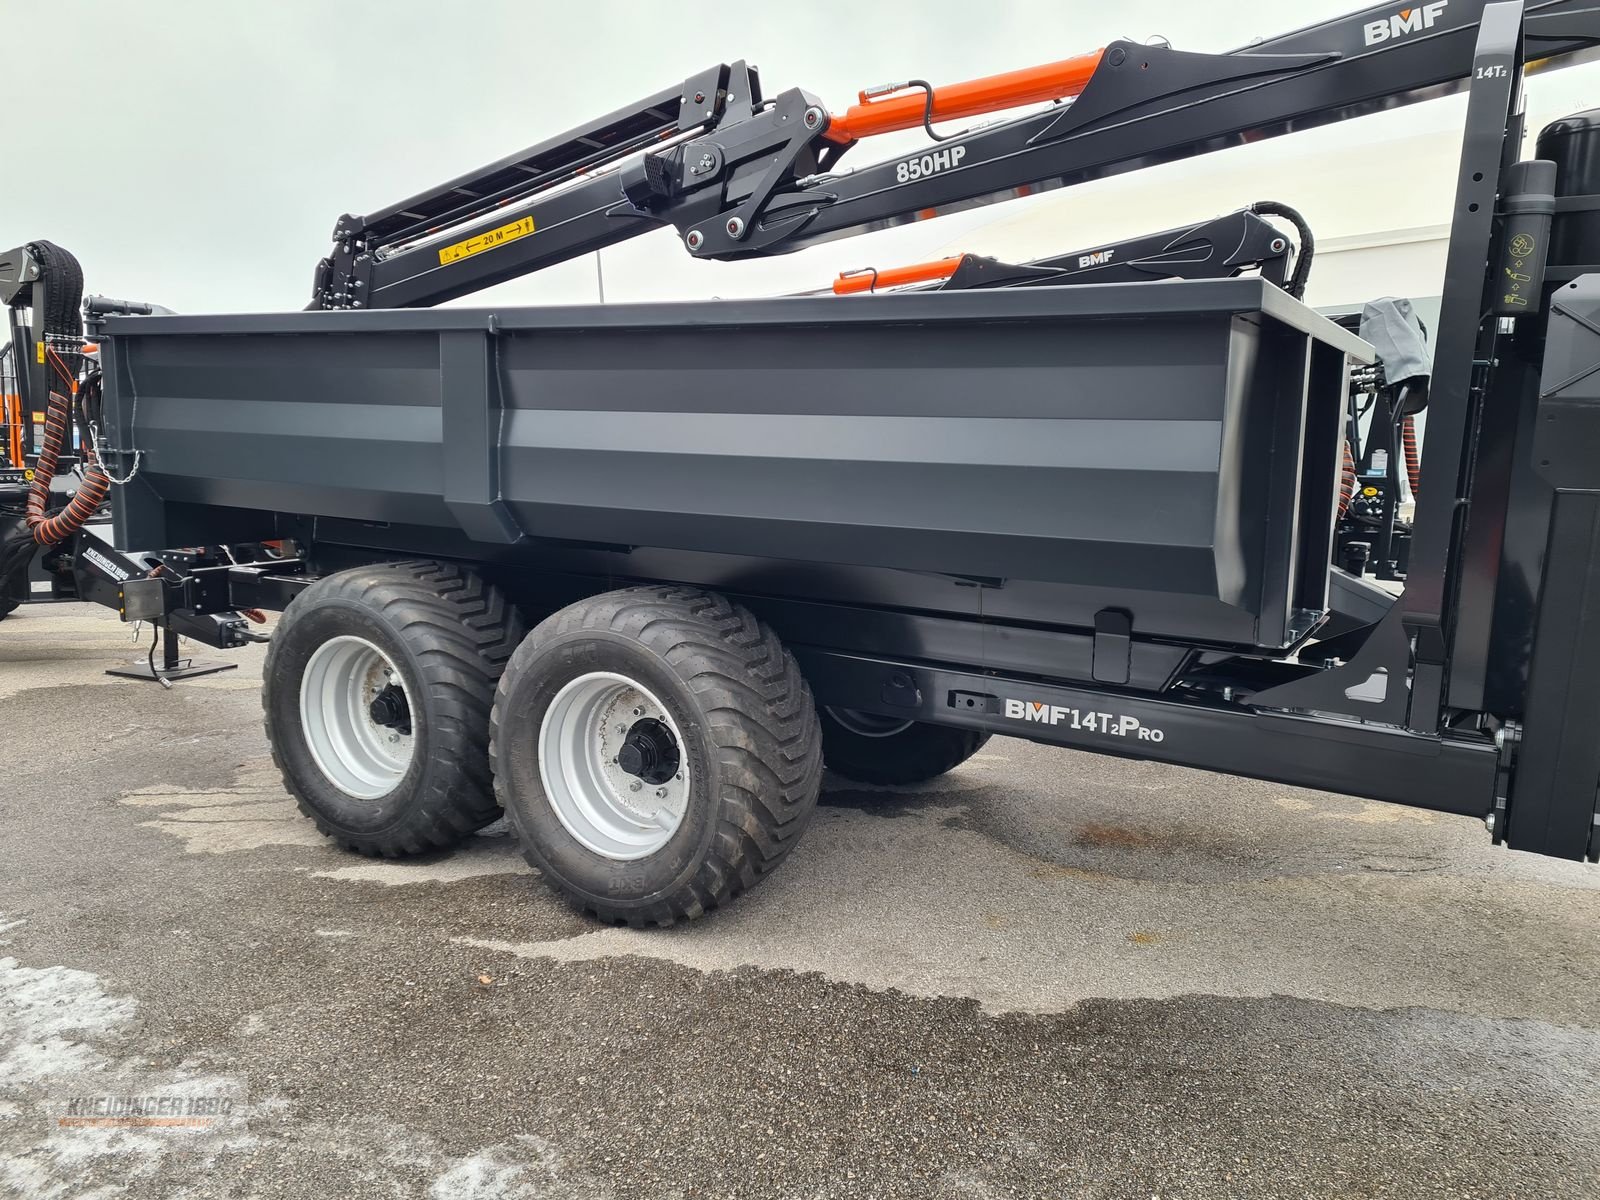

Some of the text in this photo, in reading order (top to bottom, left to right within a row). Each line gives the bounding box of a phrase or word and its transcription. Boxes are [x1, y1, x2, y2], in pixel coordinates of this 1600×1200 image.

[1363, 0, 1449, 47] BMF
[896, 145, 966, 183] 850HP
[483, 231, 504, 245] 20 M
[1078, 249, 1115, 269] BMF
